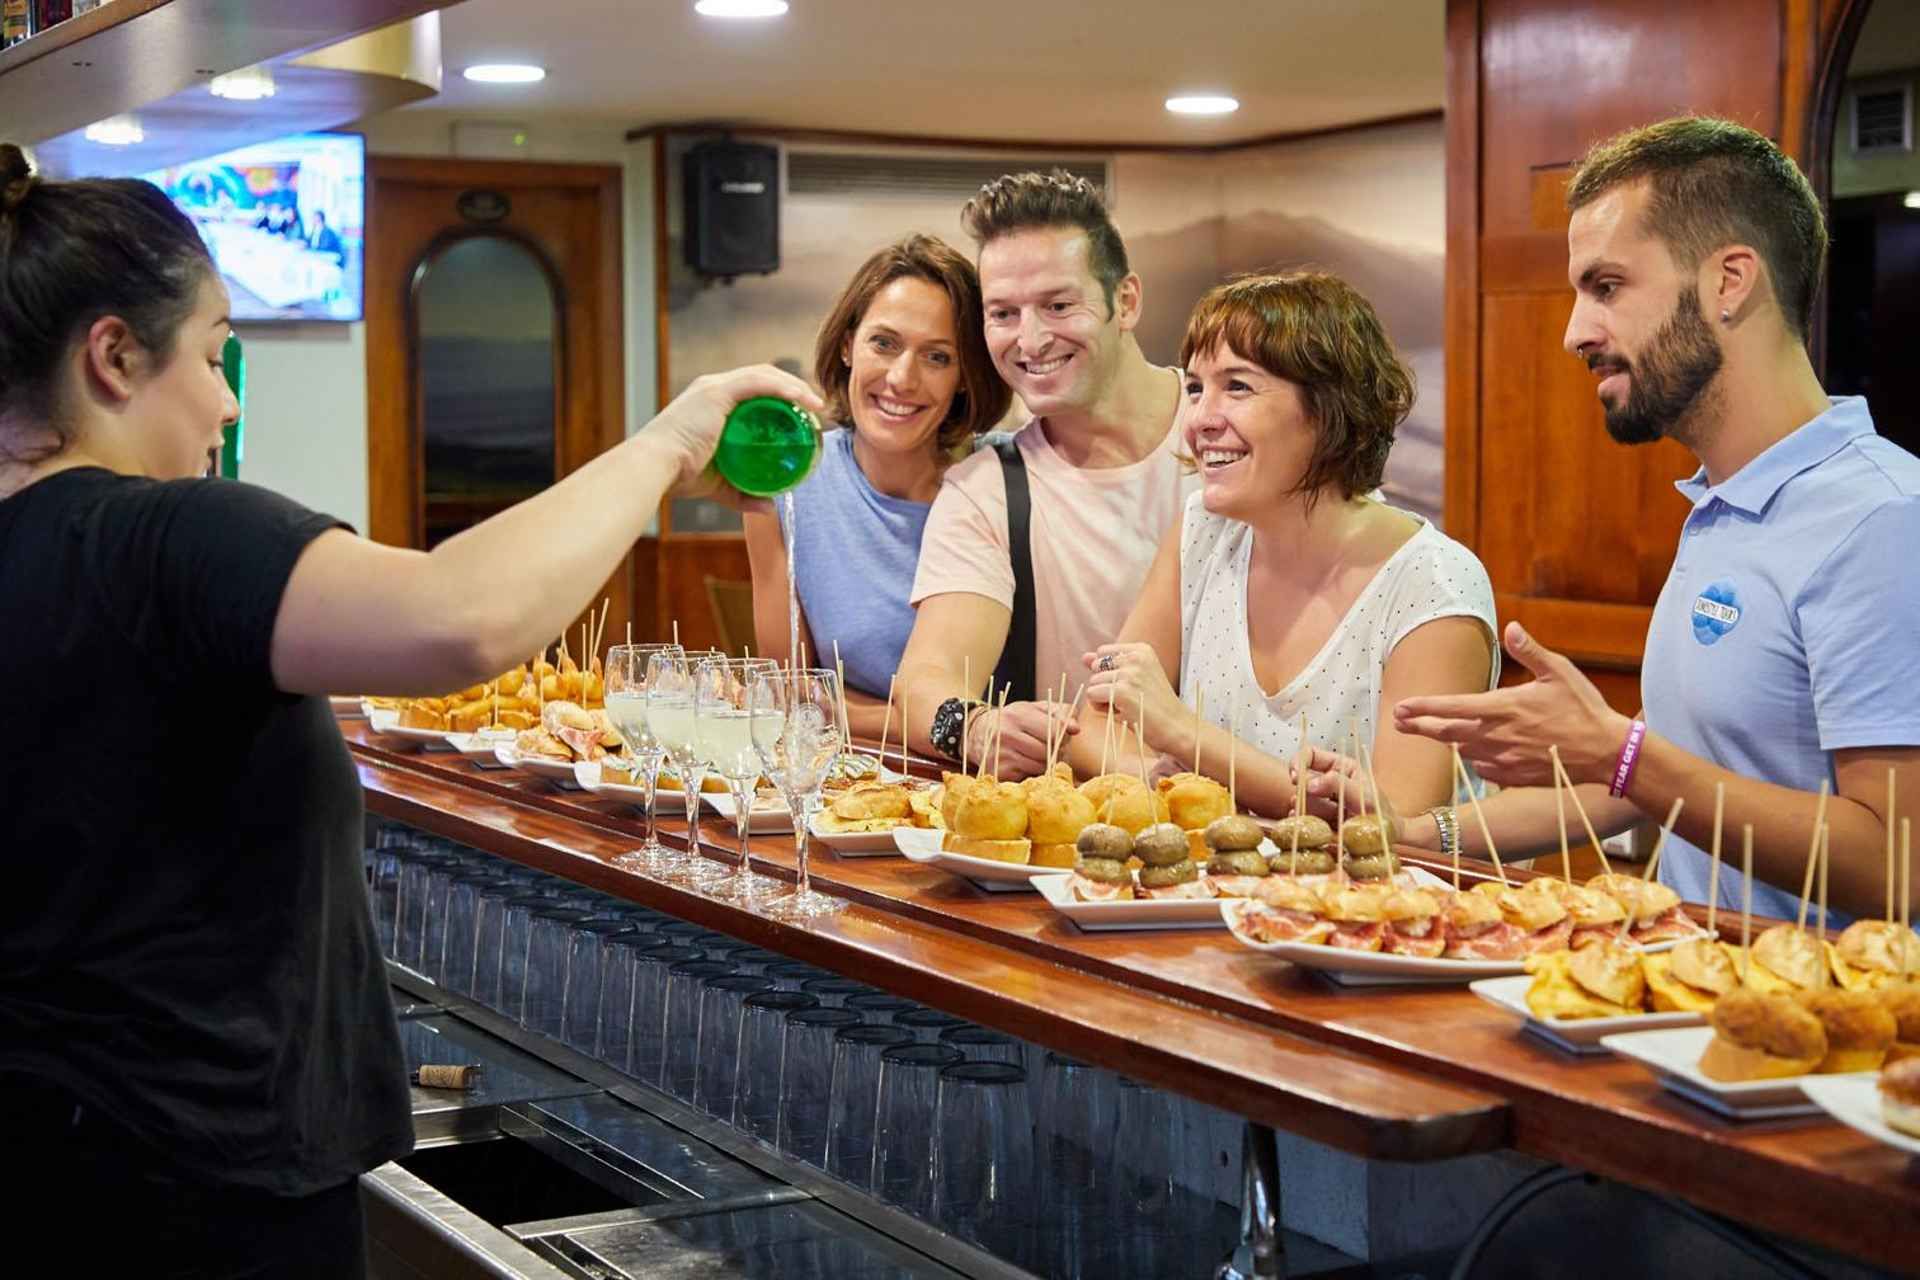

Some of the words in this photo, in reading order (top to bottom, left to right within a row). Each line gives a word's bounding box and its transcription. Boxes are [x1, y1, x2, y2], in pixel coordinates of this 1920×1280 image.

[1615, 764, 1629, 788] FEAR
[1623, 743, 1635, 763] GET
[1630, 732, 1640, 743] IN
